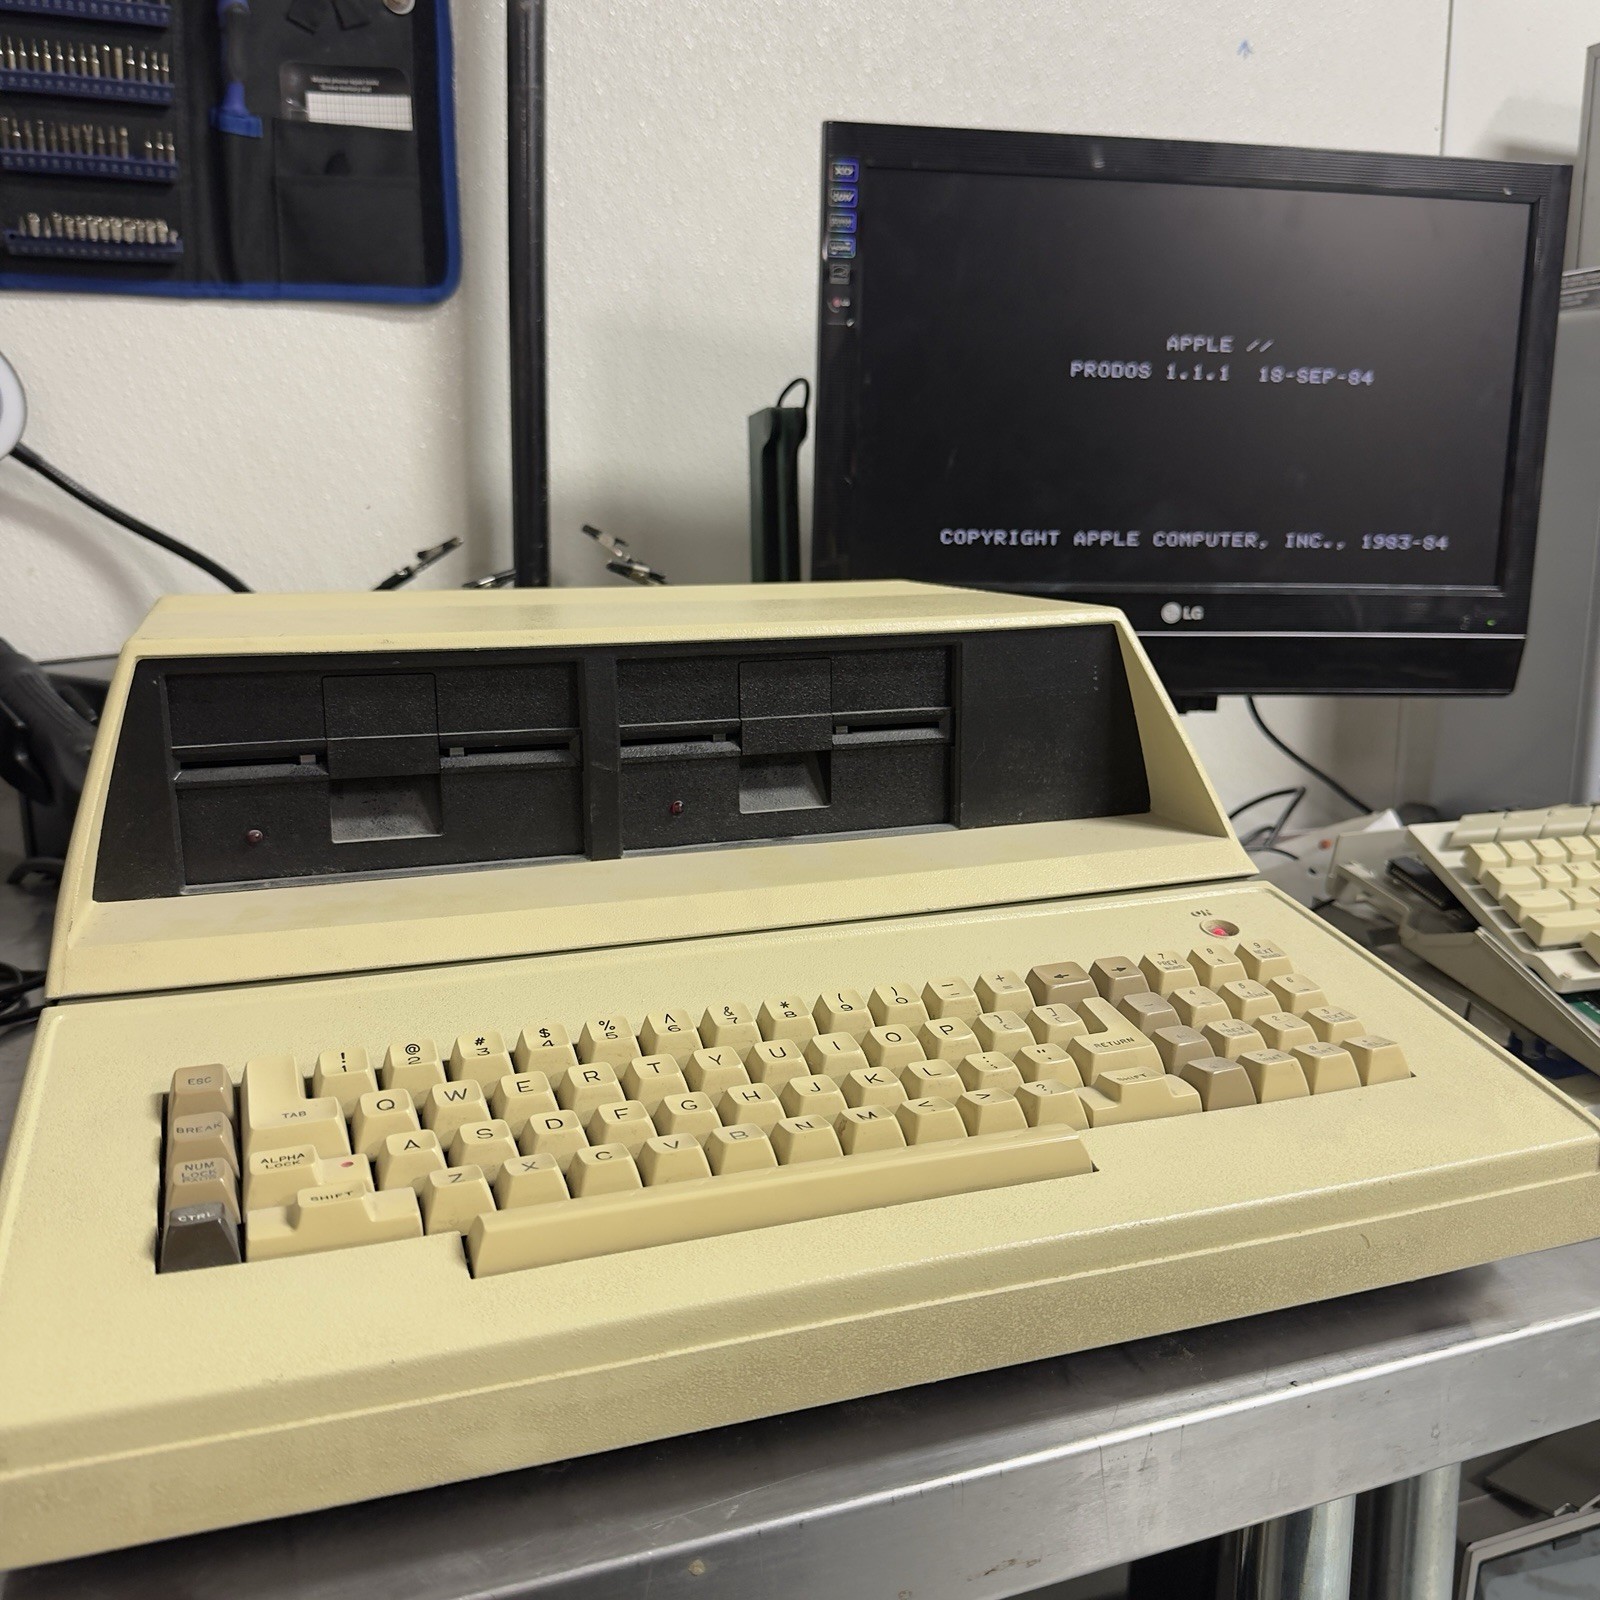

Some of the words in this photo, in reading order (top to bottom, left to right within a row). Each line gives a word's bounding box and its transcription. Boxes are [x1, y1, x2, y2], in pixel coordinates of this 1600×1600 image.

[1166, 333, 1234, 353] APPLE
[1070, 360, 1152, 379] PRODOS
[1166, 362, 1230, 382] 1.1.1
[939, 527, 1061, 546] COPYRIGHT
[1073, 529, 1141, 547] APPLE
[1152, 530, 1269, 550] COMPUTER,
[783, 1010, 798, 1019] 8
[598, 1019, 616, 1031] %
[667, 1024, 682, 1033] 6
[939, 1024, 954, 1036] P
[538, 1027, 551, 1039] $
[605, 1031, 619, 1040] 5
[474, 1036, 486, 1046] #
[541, 1039, 555, 1047] 4
[1093, 1036, 1135, 1048] RETURN
[404, 1043, 421, 1056] @
[476, 1047, 491, 1057] 3
[768, 1046, 787, 1059] U
[407, 1056, 422, 1065] 2
[708, 1054, 722, 1066] Y
[646, 1061, 661, 1074] T
[922, 1067, 941, 1077] L
[187, 1076, 212, 1086] ESC
[582, 1070, 601, 1083] R
[863, 1073, 884, 1084] K
[516, 1079, 534, 1093] E
[810, 1081, 821, 1092] J
[443, 1087, 468, 1102] W
[741, 1090, 762, 1102] H
[376, 1098, 395, 1111] Q
[680, 1099, 698, 1111] G
[281, 1110, 307, 1119] TAB
[613, 1107, 629, 1120] F
[856, 1111, 878, 1121] M
[176, 1122, 222, 1134] BREAK
[544, 1118, 564, 1130] D
[794, 1121, 814, 1131] N
[476, 1128, 494, 1139] S
[728, 1130, 749, 1140] B
[403, 1139, 421, 1151] A
[662, 1140, 679, 1150] V
[260, 1152, 306, 1165] ALPHA
[595, 1151, 613, 1161] C
[183, 1160, 216, 1172] NUM
[265, 1159, 302, 1170] LOCK
[521, 1161, 539, 1172] X
[310, 1191, 354, 1202] SHIFT
[178, 1211, 215, 1222] CTRL
